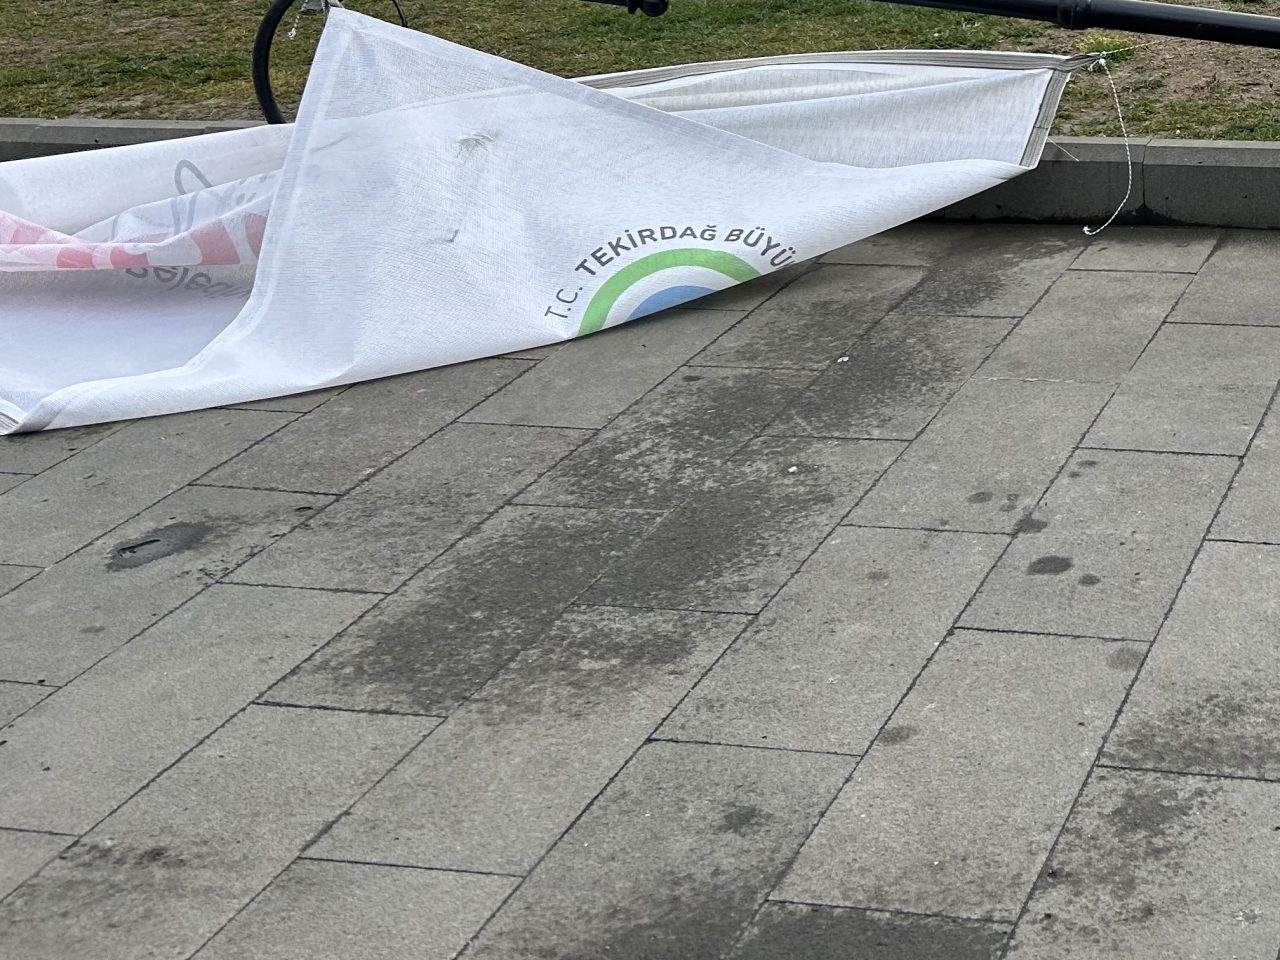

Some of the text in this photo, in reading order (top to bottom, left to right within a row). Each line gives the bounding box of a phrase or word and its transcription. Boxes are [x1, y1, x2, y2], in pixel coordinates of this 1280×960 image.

[544, 224, 797, 320] T.C. TEKİRDAĞ BÜYÜ
